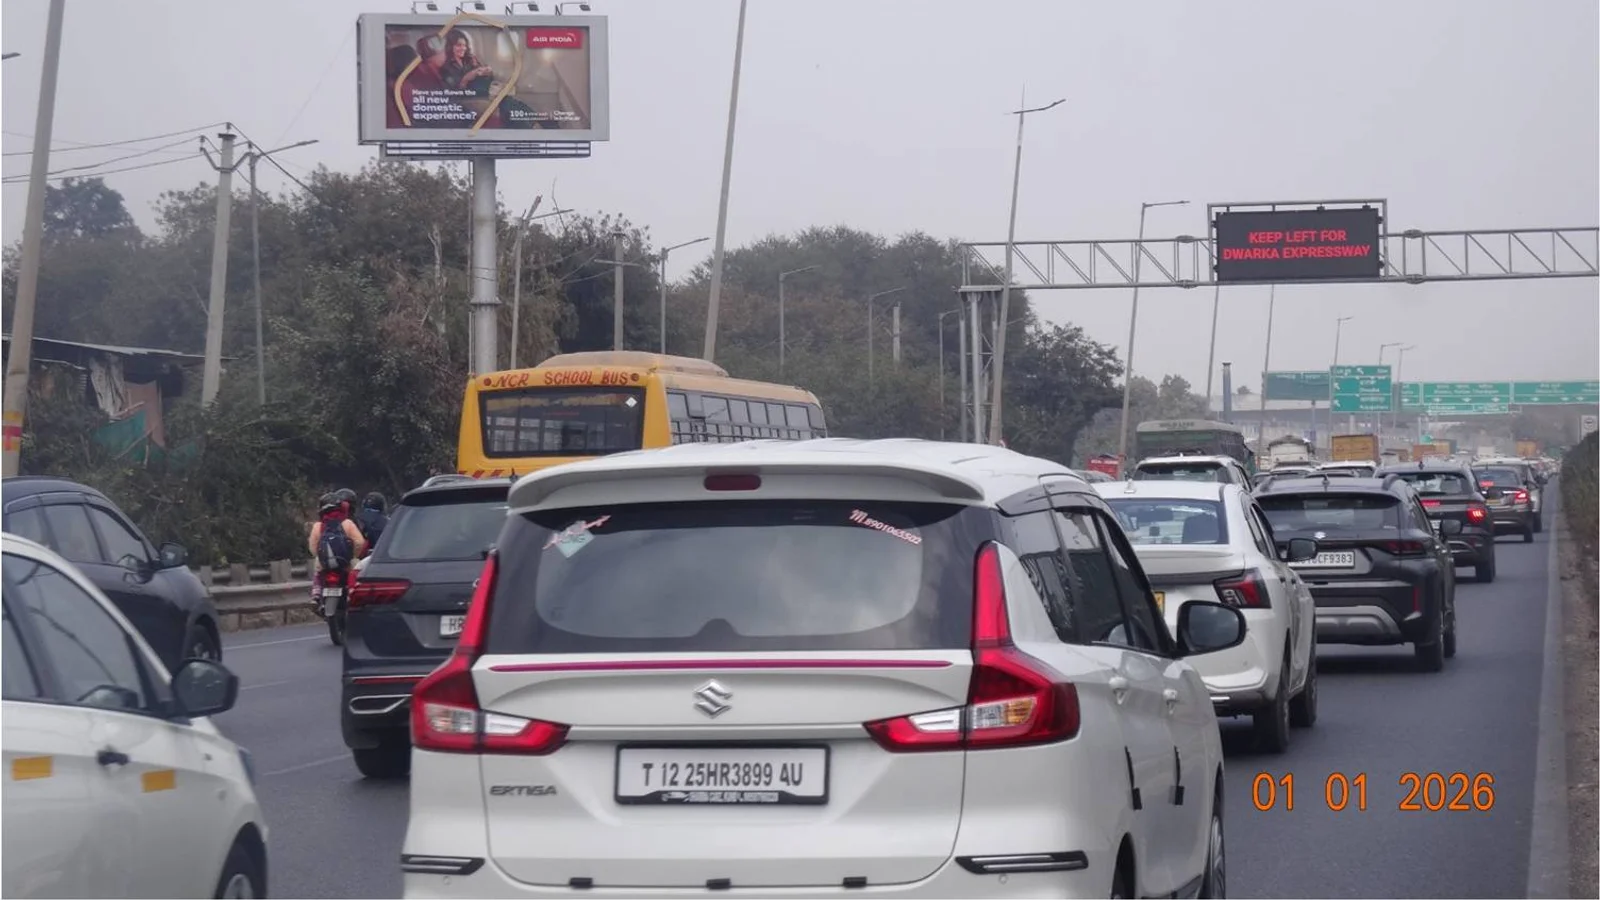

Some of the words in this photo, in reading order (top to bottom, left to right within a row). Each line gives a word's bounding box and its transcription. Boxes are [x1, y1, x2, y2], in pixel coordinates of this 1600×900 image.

[413, 96, 425, 104] all
[413, 103, 463, 111] domestic
[413, 112, 477, 121] experience?
[1249, 232, 1283, 244] KEEP
[1286, 231, 1317, 243] LEFT
[1320, 230, 1346, 242] FOR
[1223, 248, 1279, 260] DWARKA
[1282, 245, 1371, 259] EXPRESSWAY
[492, 373, 529, 388] NCR
[544, 371, 593, 385] SCHOOL
[601, 372, 628, 385] BUS
[642, 762, 654, 787] T
[661, 762, 679, 787] 12
[684, 762, 773, 787] 25HR3899
[489, 785, 557, 796] ERTIGA
